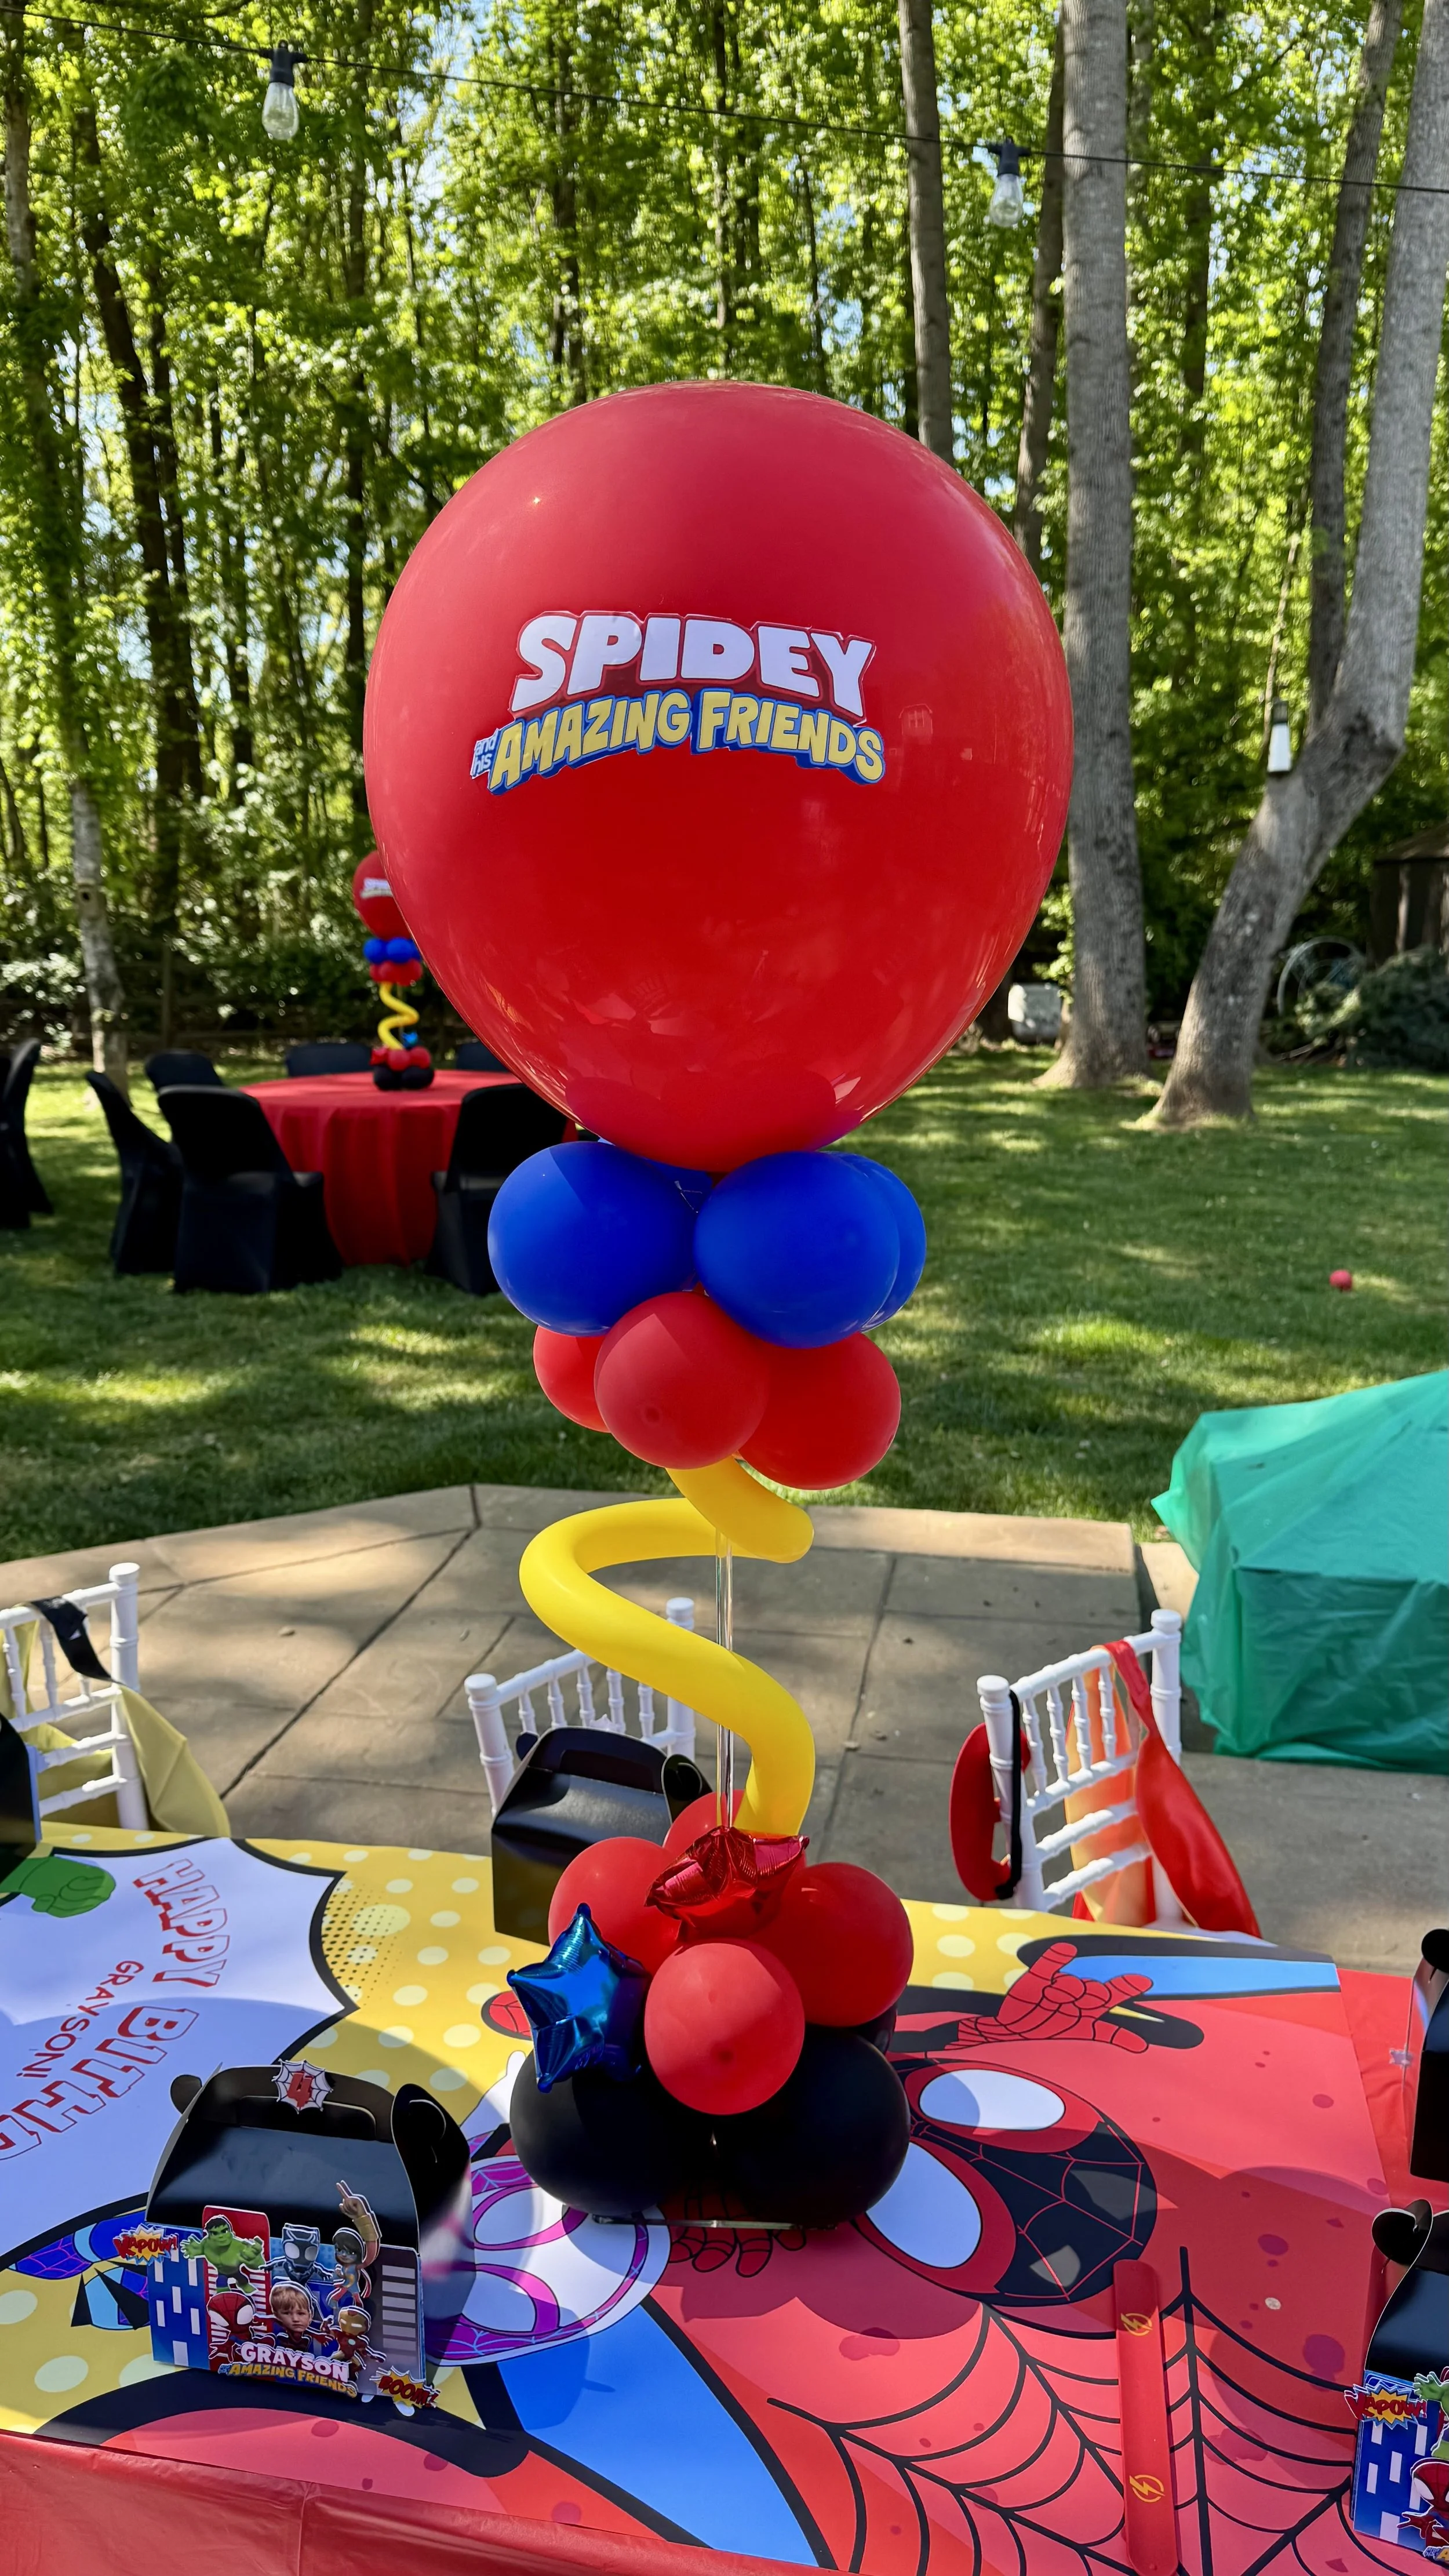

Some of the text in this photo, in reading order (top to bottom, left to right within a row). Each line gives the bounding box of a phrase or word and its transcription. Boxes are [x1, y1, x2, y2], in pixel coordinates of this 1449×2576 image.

[510, 613, 874, 718] SPIDEY
[474, 729, 498, 756] and
[489, 690, 885, 791] AMAZING FRIENDS
[472, 753, 493, 776] his
[132, 1858, 230, 1988] HAPPY
[16, 1960, 144, 2078] GRAYSON!
[112, 2234, 177, 2260] KAPOW!
[241, 2342, 350, 2382] GRAYSON
[228, 2363, 295, 2378] AMAZING
[297, 2368, 358, 2399] FRIENDS
[378, 2375, 439, 2408] BOOM!
[1344, 2392, 1428, 2421] KAPOW!
